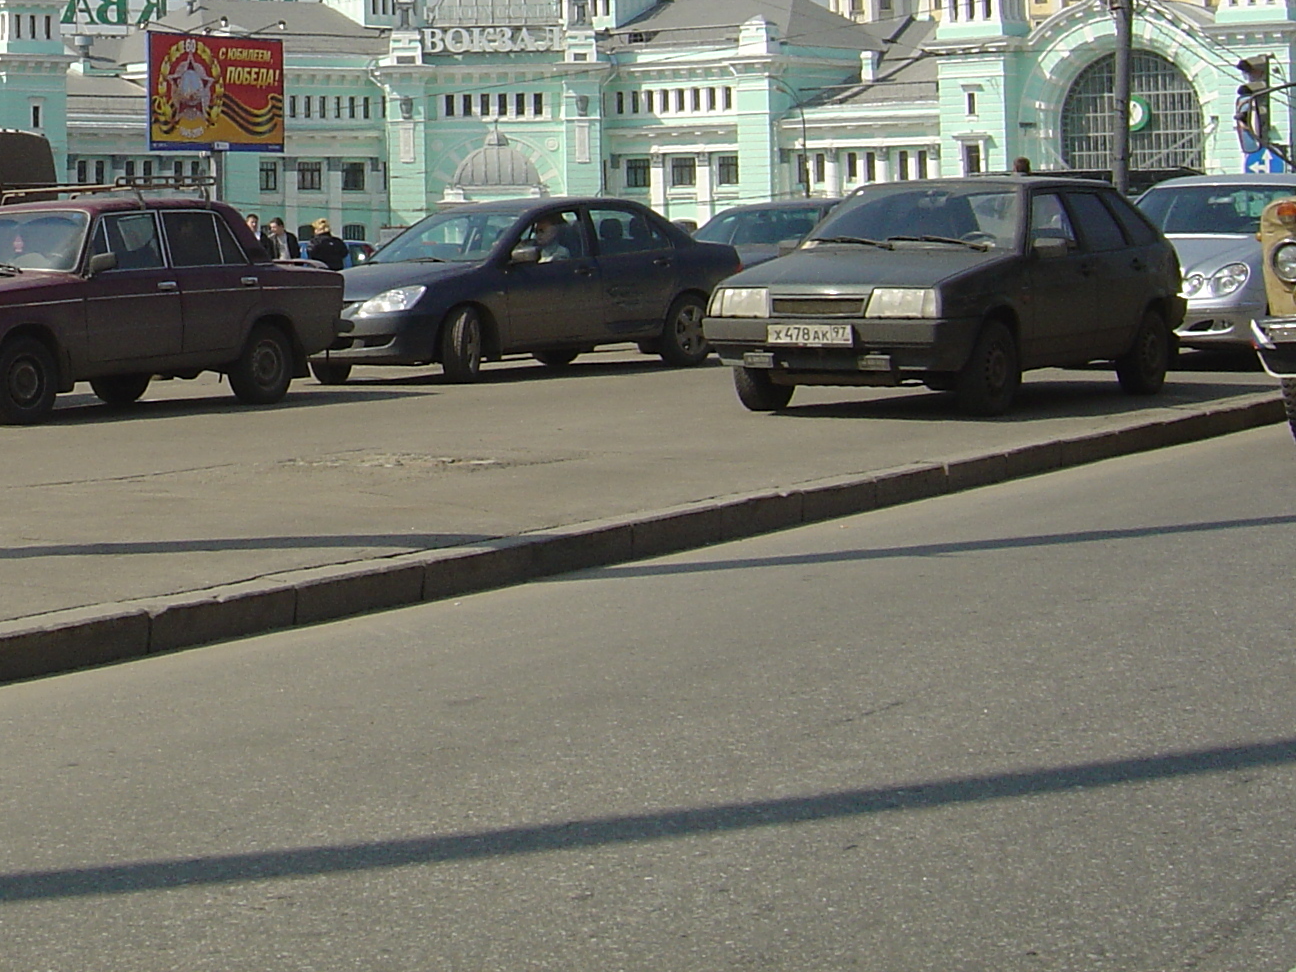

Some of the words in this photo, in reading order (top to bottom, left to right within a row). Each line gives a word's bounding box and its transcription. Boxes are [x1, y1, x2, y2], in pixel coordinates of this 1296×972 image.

[422, 27, 566, 53] ВОКЗАЛ
[219, 47, 226, 60] С
[227, 47, 273, 64] ЮБИЛЕЕМ,
[226, 66, 280, 89] ПОБЕДА!
